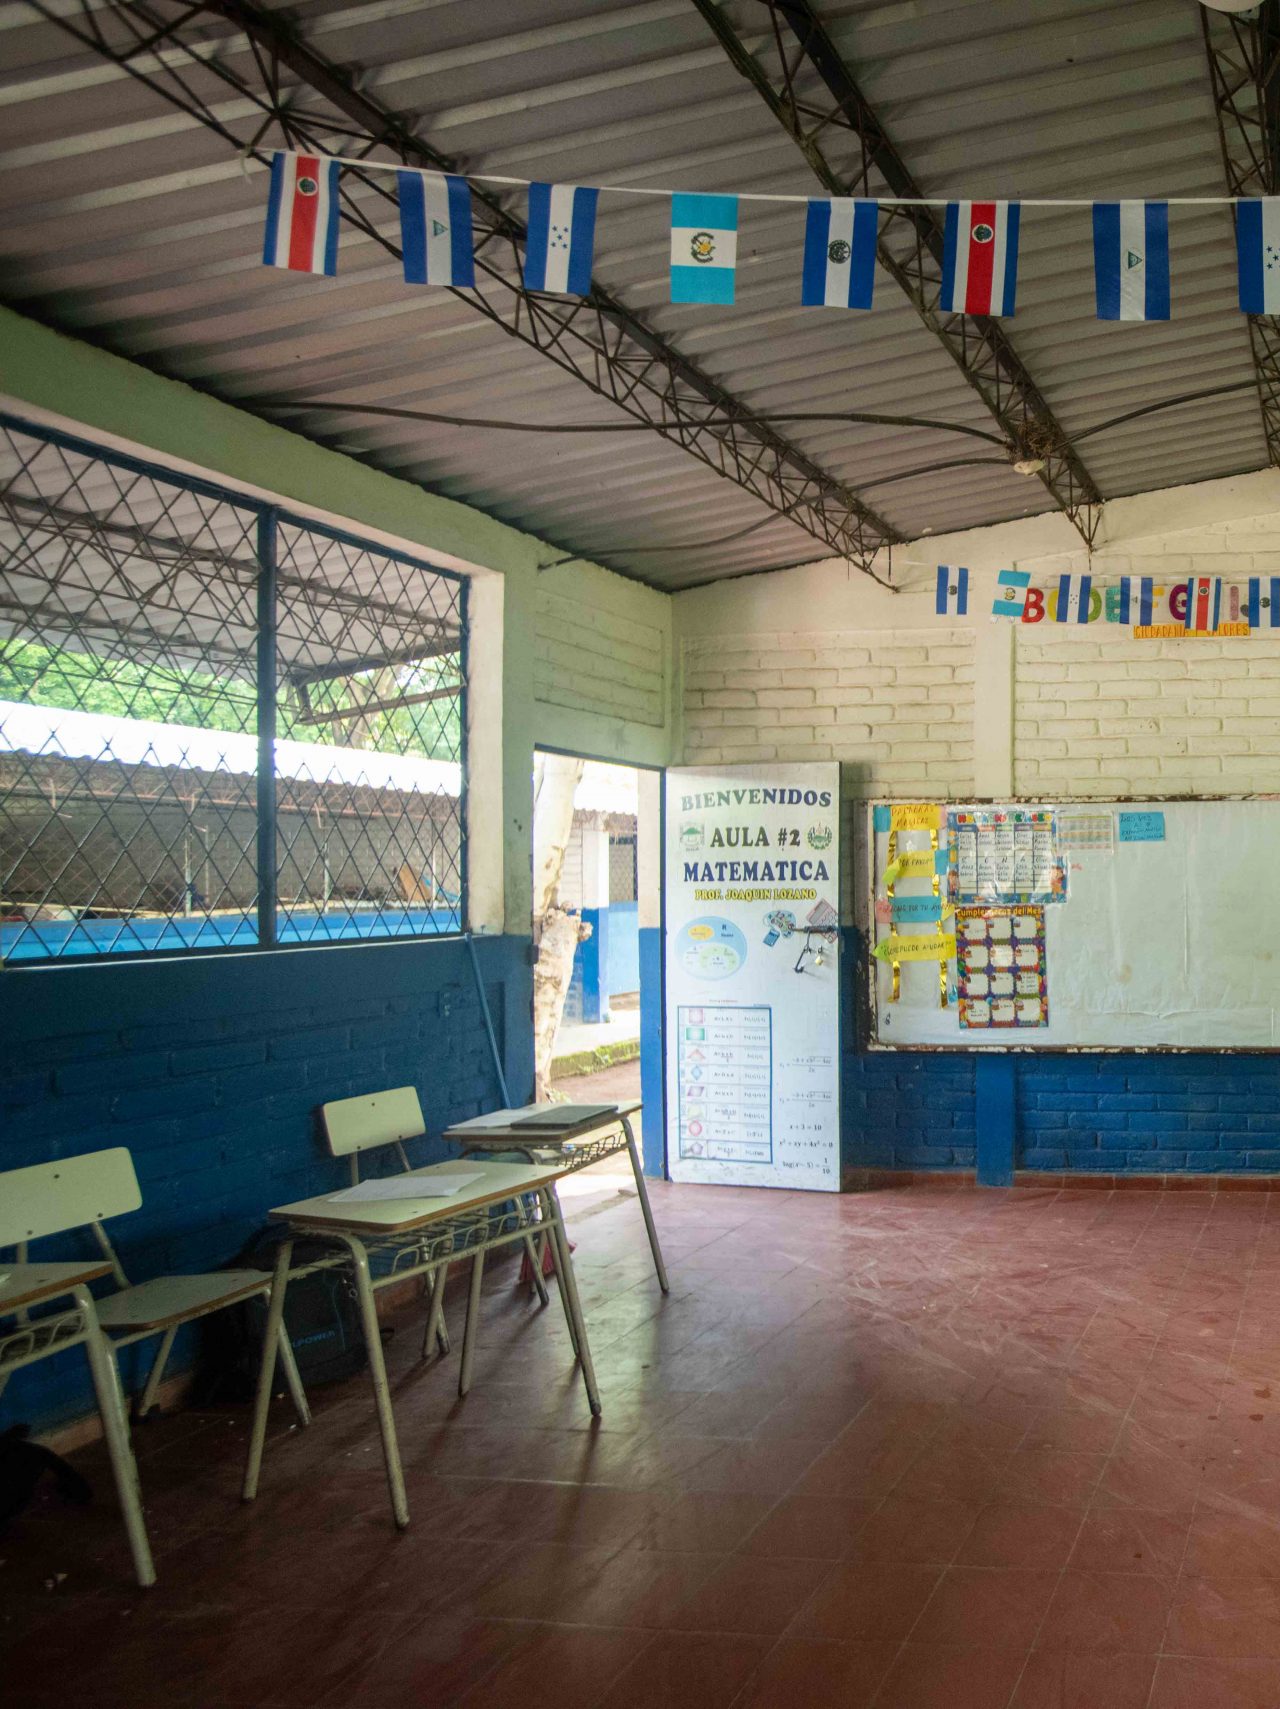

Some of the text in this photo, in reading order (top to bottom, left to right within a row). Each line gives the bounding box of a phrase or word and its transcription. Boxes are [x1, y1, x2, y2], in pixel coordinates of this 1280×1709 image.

[681, 788, 832, 811] BIENVENIDOS
[710, 826, 801, 848] AULA #2
[684, 860, 830, 882] MATEMATICA
[695, 887, 817, 903] PROF. JOAQUIN LOZANO
